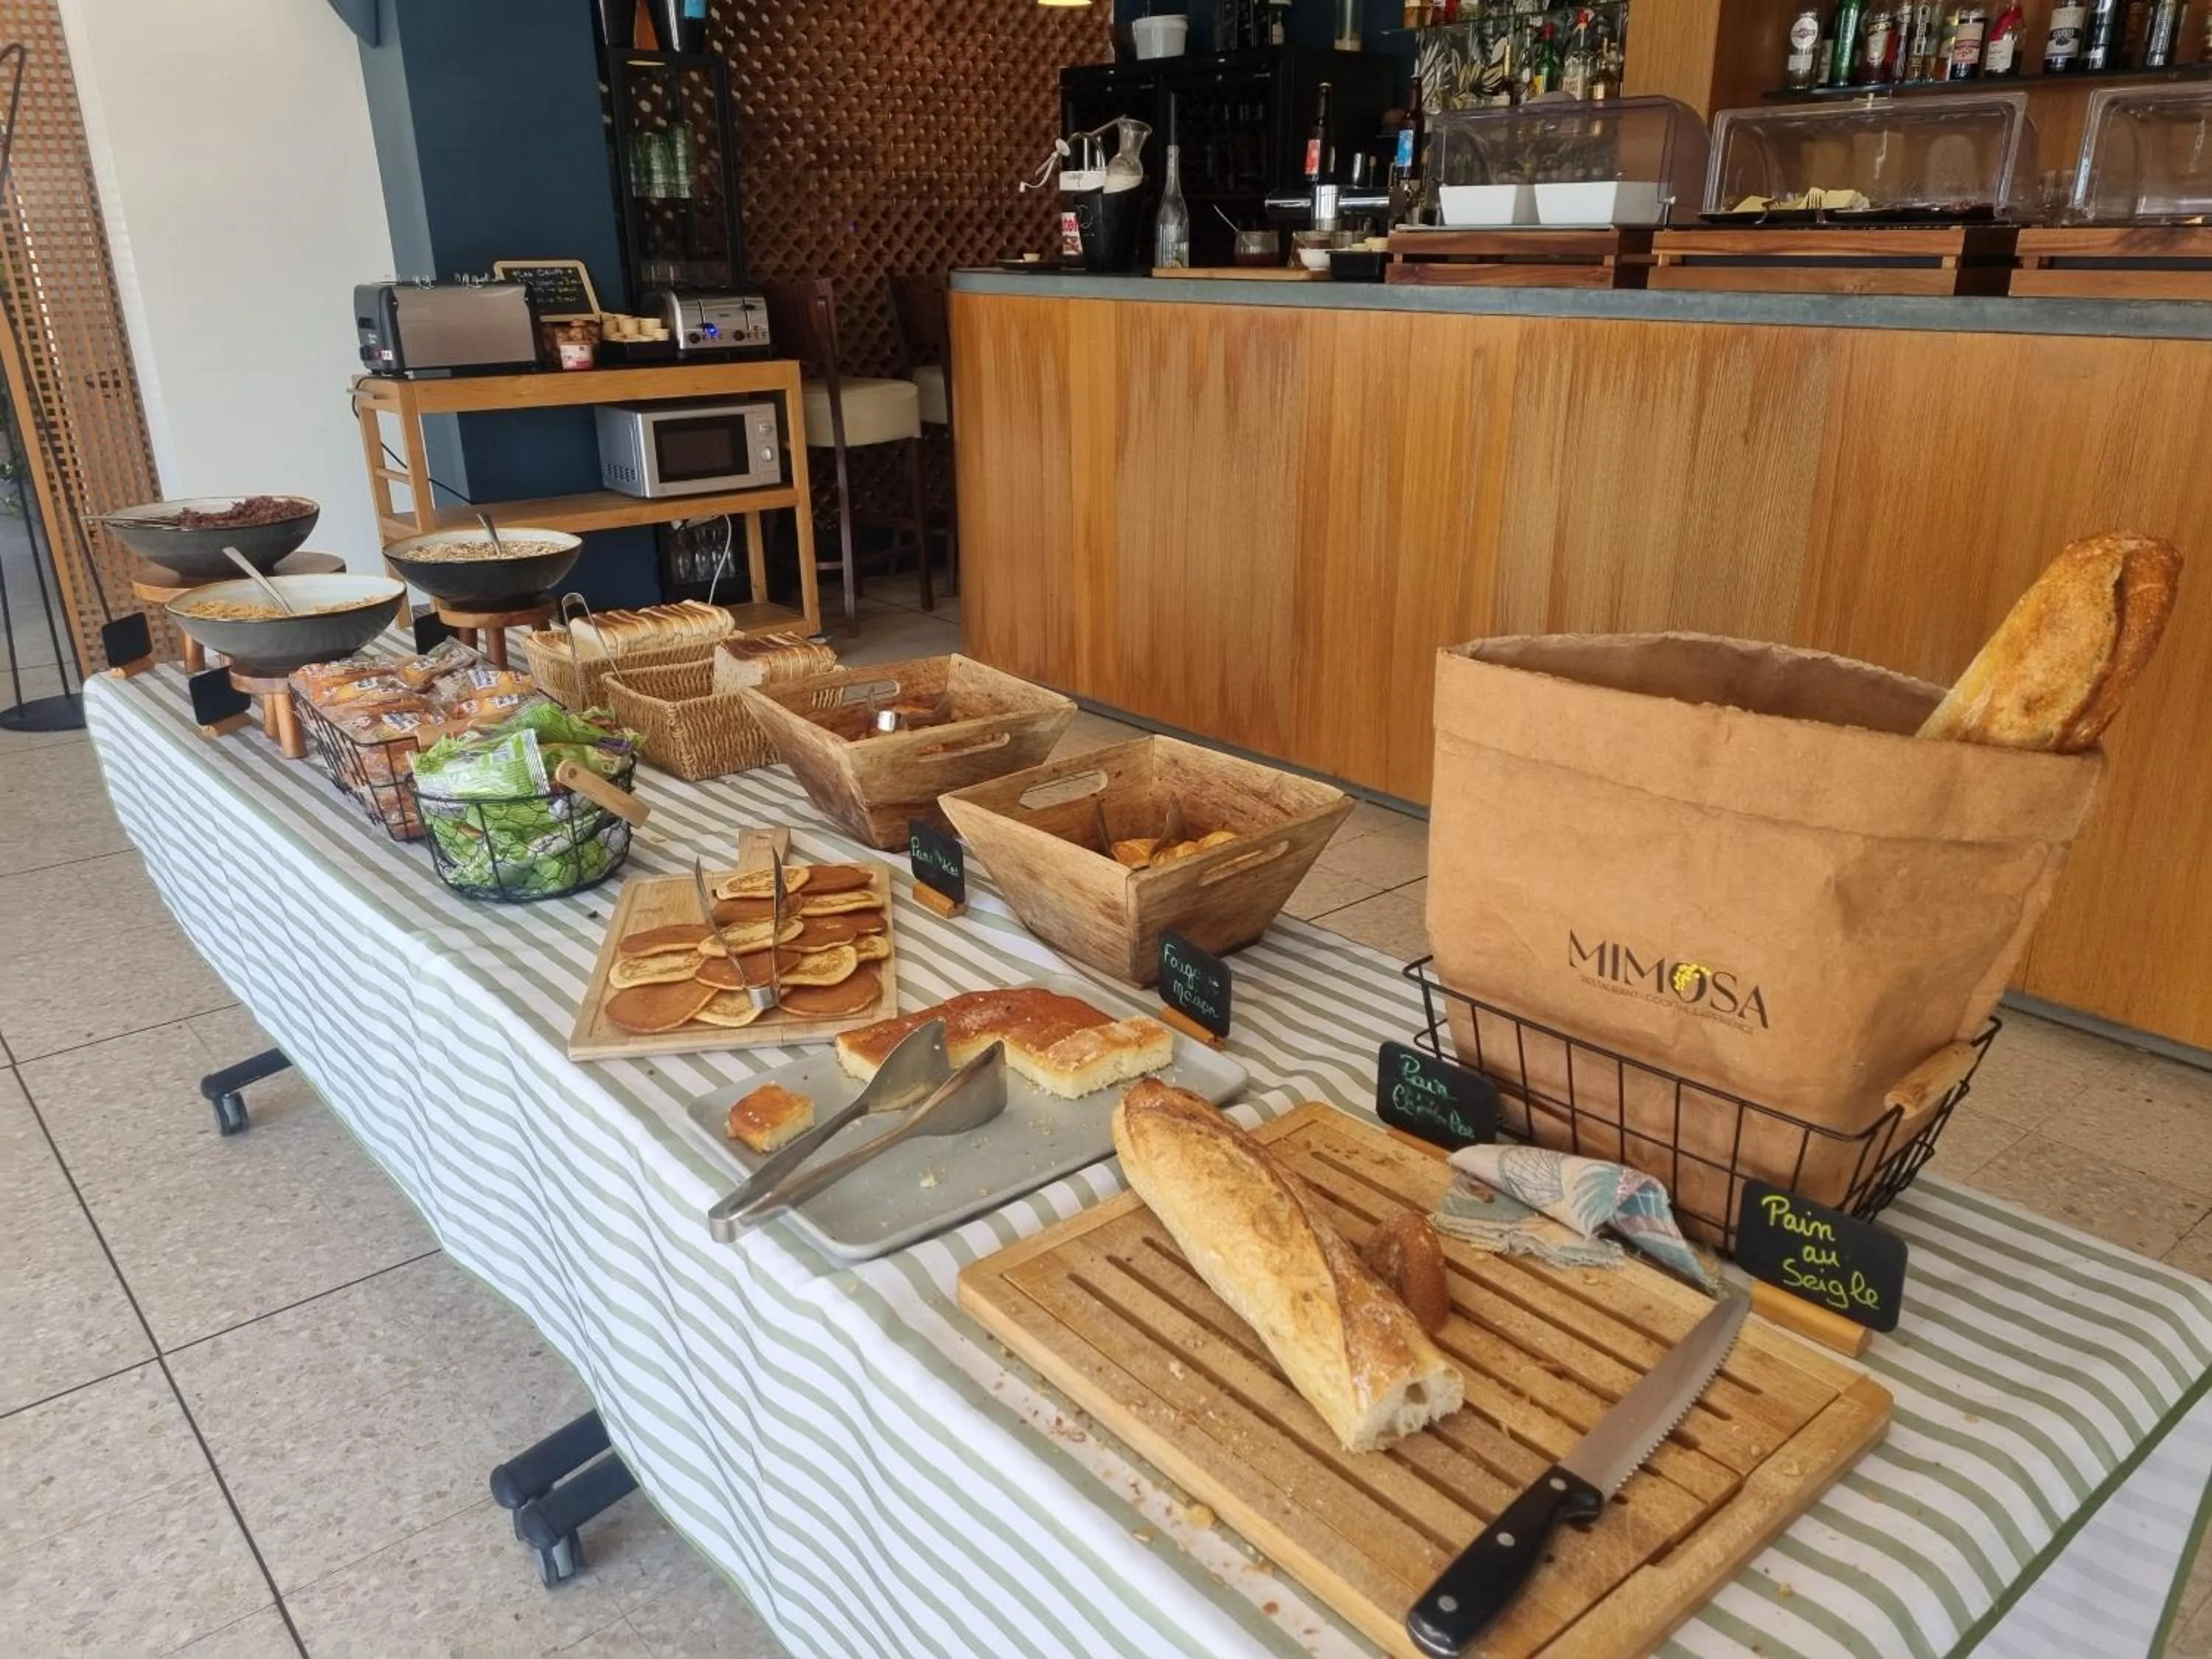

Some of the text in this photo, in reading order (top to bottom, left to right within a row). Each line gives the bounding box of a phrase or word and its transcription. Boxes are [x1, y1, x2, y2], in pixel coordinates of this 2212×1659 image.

[1568, 928, 1769, 1029] MIMOSA
[1761, 1195, 1835, 1241] Pain
[1801, 1245, 1840, 1267] au
[1782, 1258, 1879, 1310] Seigle
